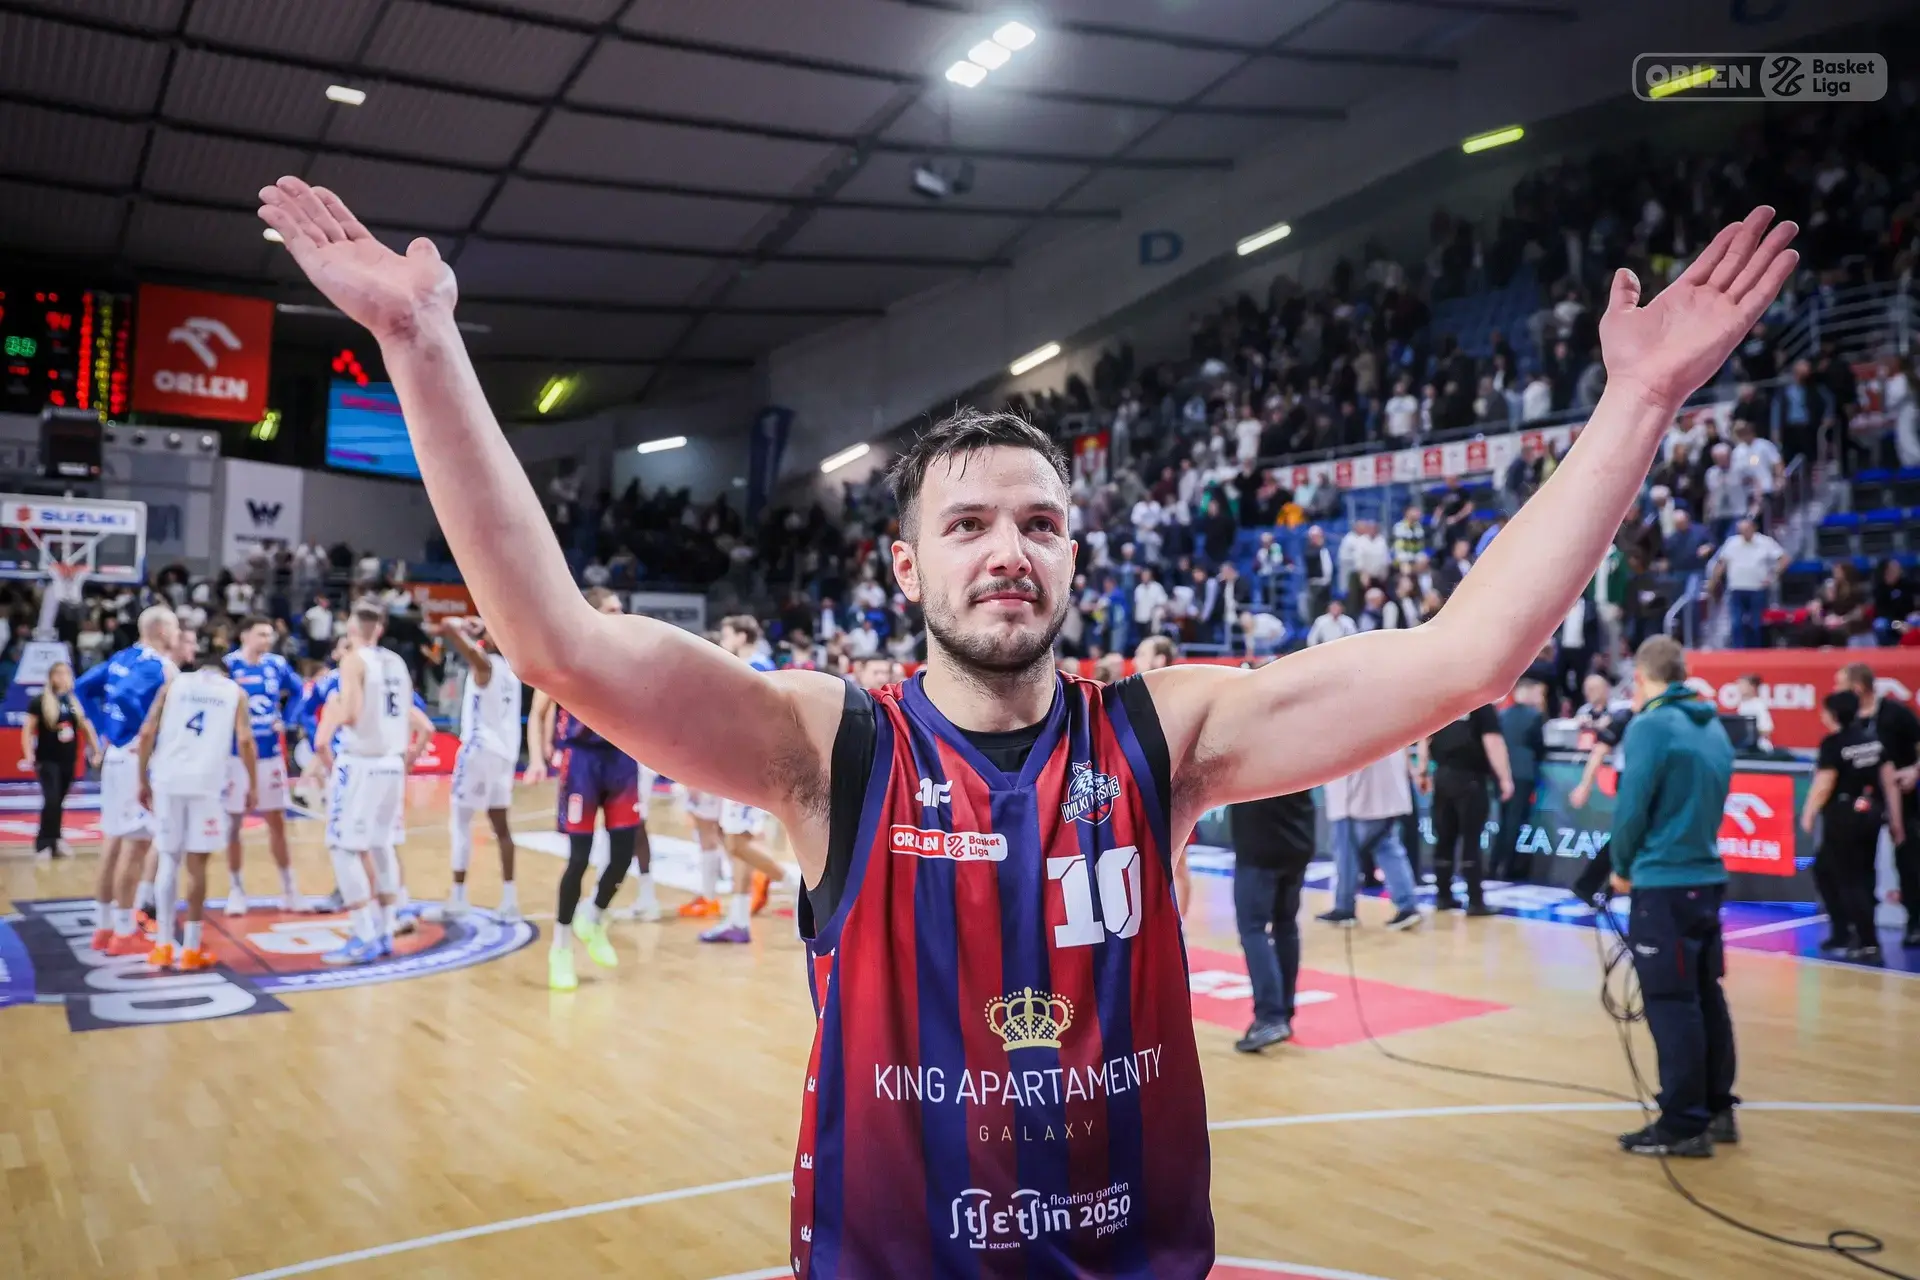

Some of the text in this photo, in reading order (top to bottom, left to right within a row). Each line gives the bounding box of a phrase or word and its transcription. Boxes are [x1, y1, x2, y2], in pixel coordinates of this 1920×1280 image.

[1139, 230, 1183, 266] D
[153, 370, 248, 401] ORLEN
[186, 710, 205, 736] 4
[1063, 795, 1090, 820] WILKI
[893, 831, 939, 851] ORLEN
[968, 836, 1000, 847] Basket
[969, 847, 989, 857] Liga
[1515, 824, 1552, 855] ZA
[1047, 845, 1142, 948] 10
[874, 1043, 1163, 1107] KING APARTAMENTY
[978, 1119, 1094, 1142] GALAXY
[1050, 1182, 1129, 1207] floating garden
[1079, 1194, 1131, 1228] 2050
[1096, 1217, 1128, 1239] project
[989, 1240, 1021, 1250] szczecin
